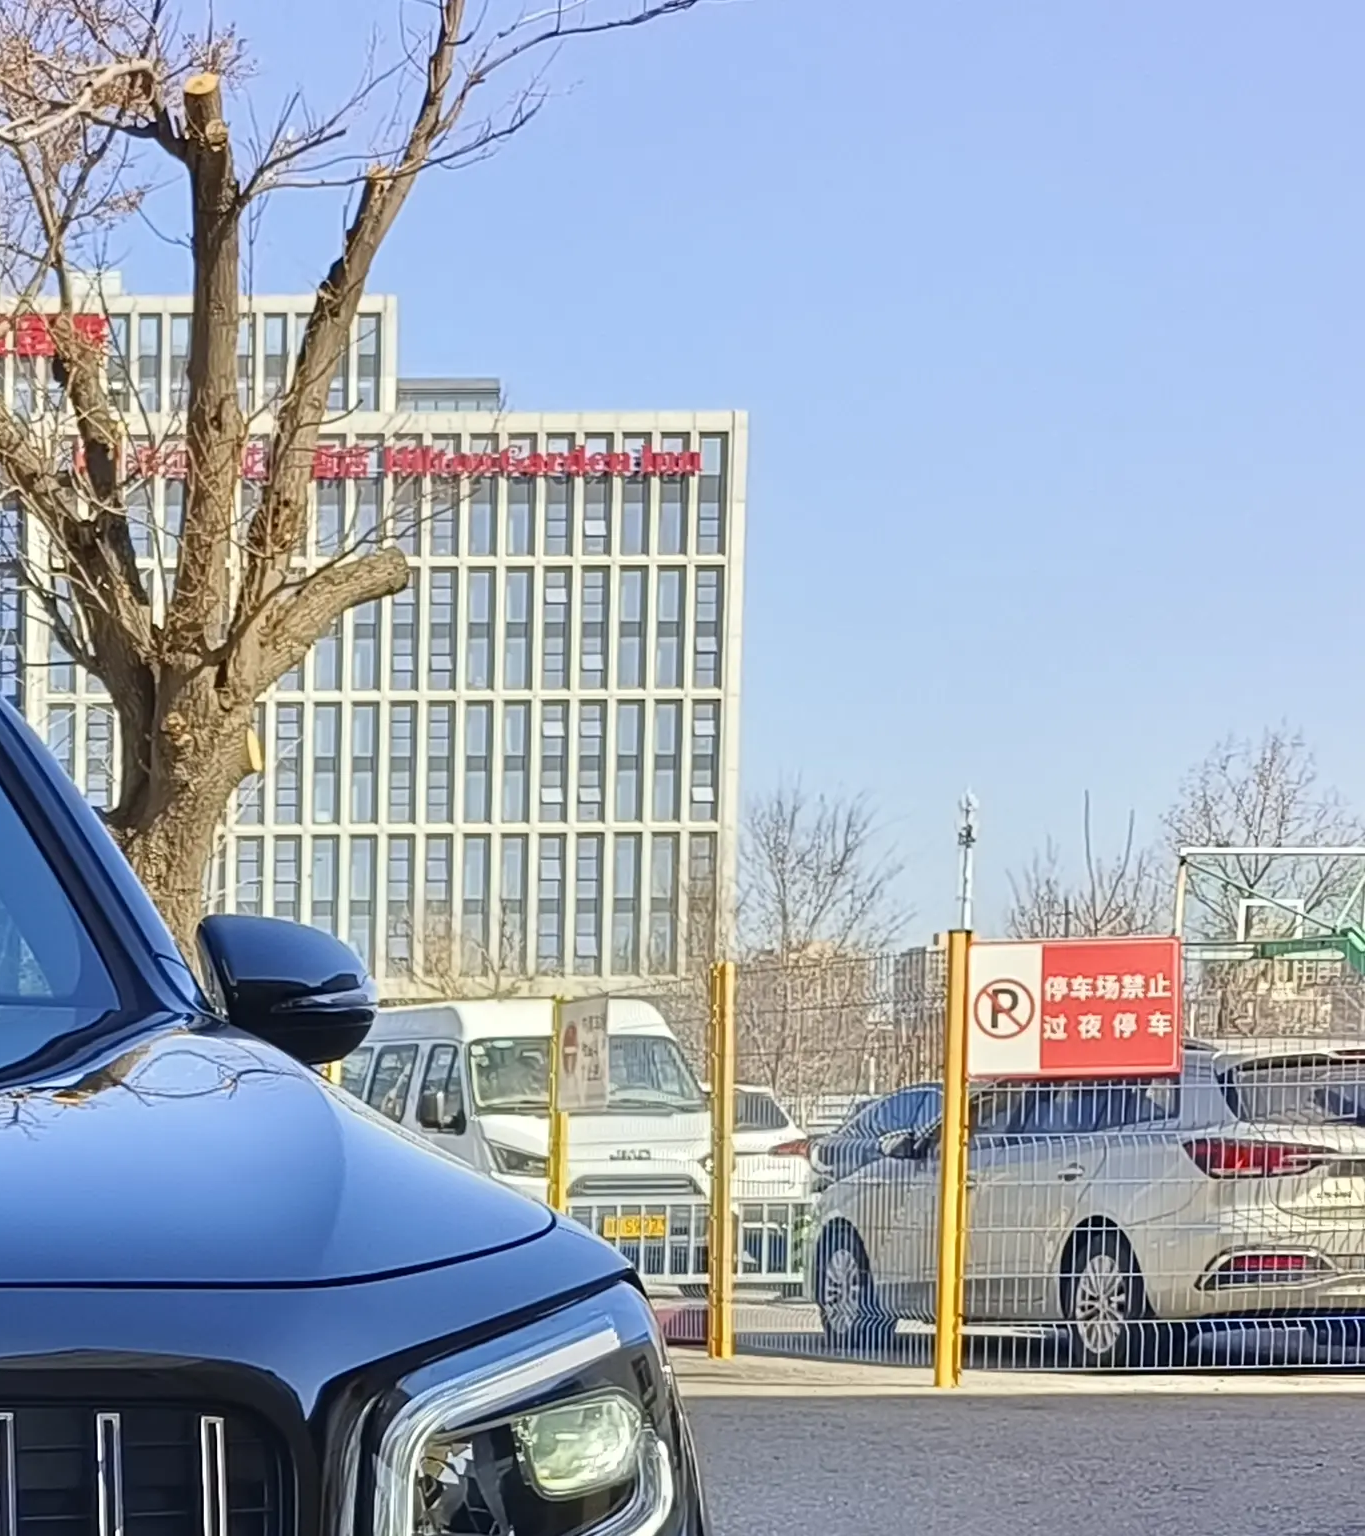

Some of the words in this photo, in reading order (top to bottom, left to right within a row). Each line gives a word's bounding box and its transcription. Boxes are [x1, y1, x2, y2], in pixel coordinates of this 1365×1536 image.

[499, 444, 632, 477] Garden
[1044, 973, 1173, 1003] 停车场禁止
[1043, 1011, 1173, 1041] 过夜停车
